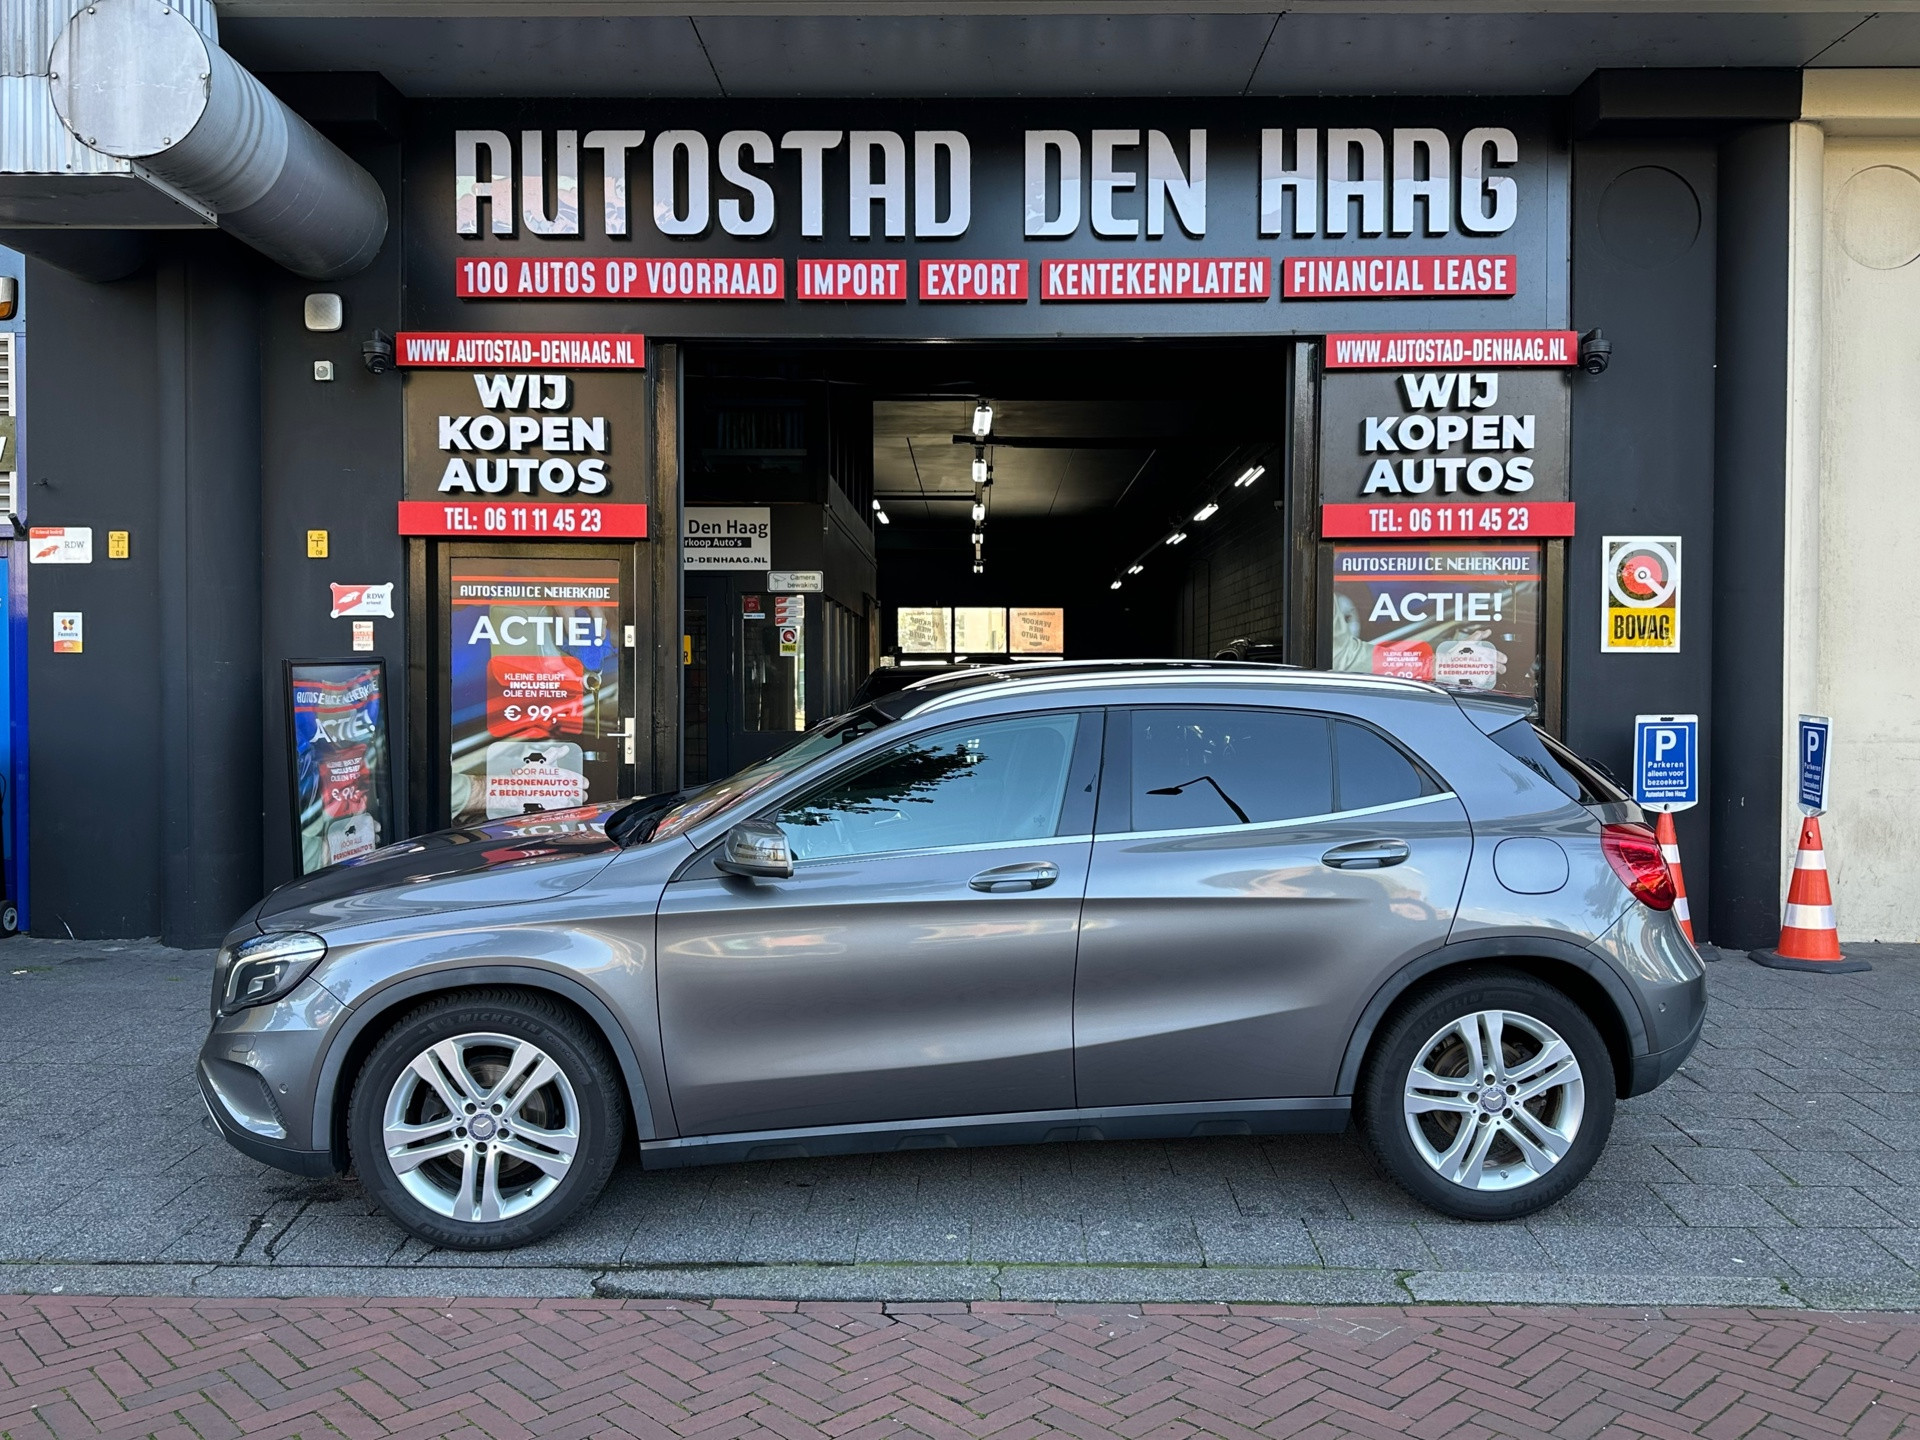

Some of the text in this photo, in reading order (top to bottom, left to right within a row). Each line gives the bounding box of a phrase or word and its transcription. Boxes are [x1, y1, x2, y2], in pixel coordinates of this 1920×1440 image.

[455, 127, 1518, 237] AUTOSTAD DEN HAAG
[464, 262, 778, 296] 100 AUTOS OP VOORRAAD
[804, 263, 899, 296] IMPORT
[927, 262, 1020, 296] EXPORT
[1048, 260, 1265, 296] KENTEKENPLATEN
[1294, 258, 1507, 293] FINANCIAL LEASE
[406, 339, 634, 364] WWW.AUTOSTAD-DENHAAG.NL
[1337, 338, 1567, 363] WWW.AUTOSTAD-DENHAAG.NL
[474, 374, 567, 409] WIJ
[1403, 373, 1498, 408] WIJ
[438, 415, 605, 450] KOPEN
[1365, 414, 1535, 451] KOPEN
[438, 458, 607, 494] AUTOS
[1363, 457, 1534, 494] AUTOS
[444, 507, 601, 532] TEL: 06 11 11 45 23
[689, 519, 768, 538] Den Haag
[1369, 508, 1528, 532] TEL: 06 11 11 45 23
[713, 538, 742, 547] Auto's
[1342, 556, 1530, 572] AUTOSERVICE NEHERKADE
[460, 585, 610, 599] AUTOSERVICE NEHERKADE
[1368, 592, 1503, 622] ACTIE!
[468, 615, 603, 647] ACTIE!
[1614, 614, 1670, 640] BOVAG
[504, 673, 566, 681] KLEINE BEURT
[509, 681, 560, 690] INCLUSIEF
[503, 690, 567, 698] OLIE EN FILTER
[504, 705, 567, 724] € 99,-
[1655, 730, 1677, 761] P
[1807, 731, 1819, 762] P
[511, 768, 559, 776] VOOR ALLE
[1648, 761, 1684, 769] Parkeren
[489, 789, 580, 797] & BEDRIJFSAUTO'S
[491, 779, 578, 787] PERSONENAUTO'S
[1675, 790, 1686, 798] Haag
[458, 1013, 540, 1034] MICHELIN
